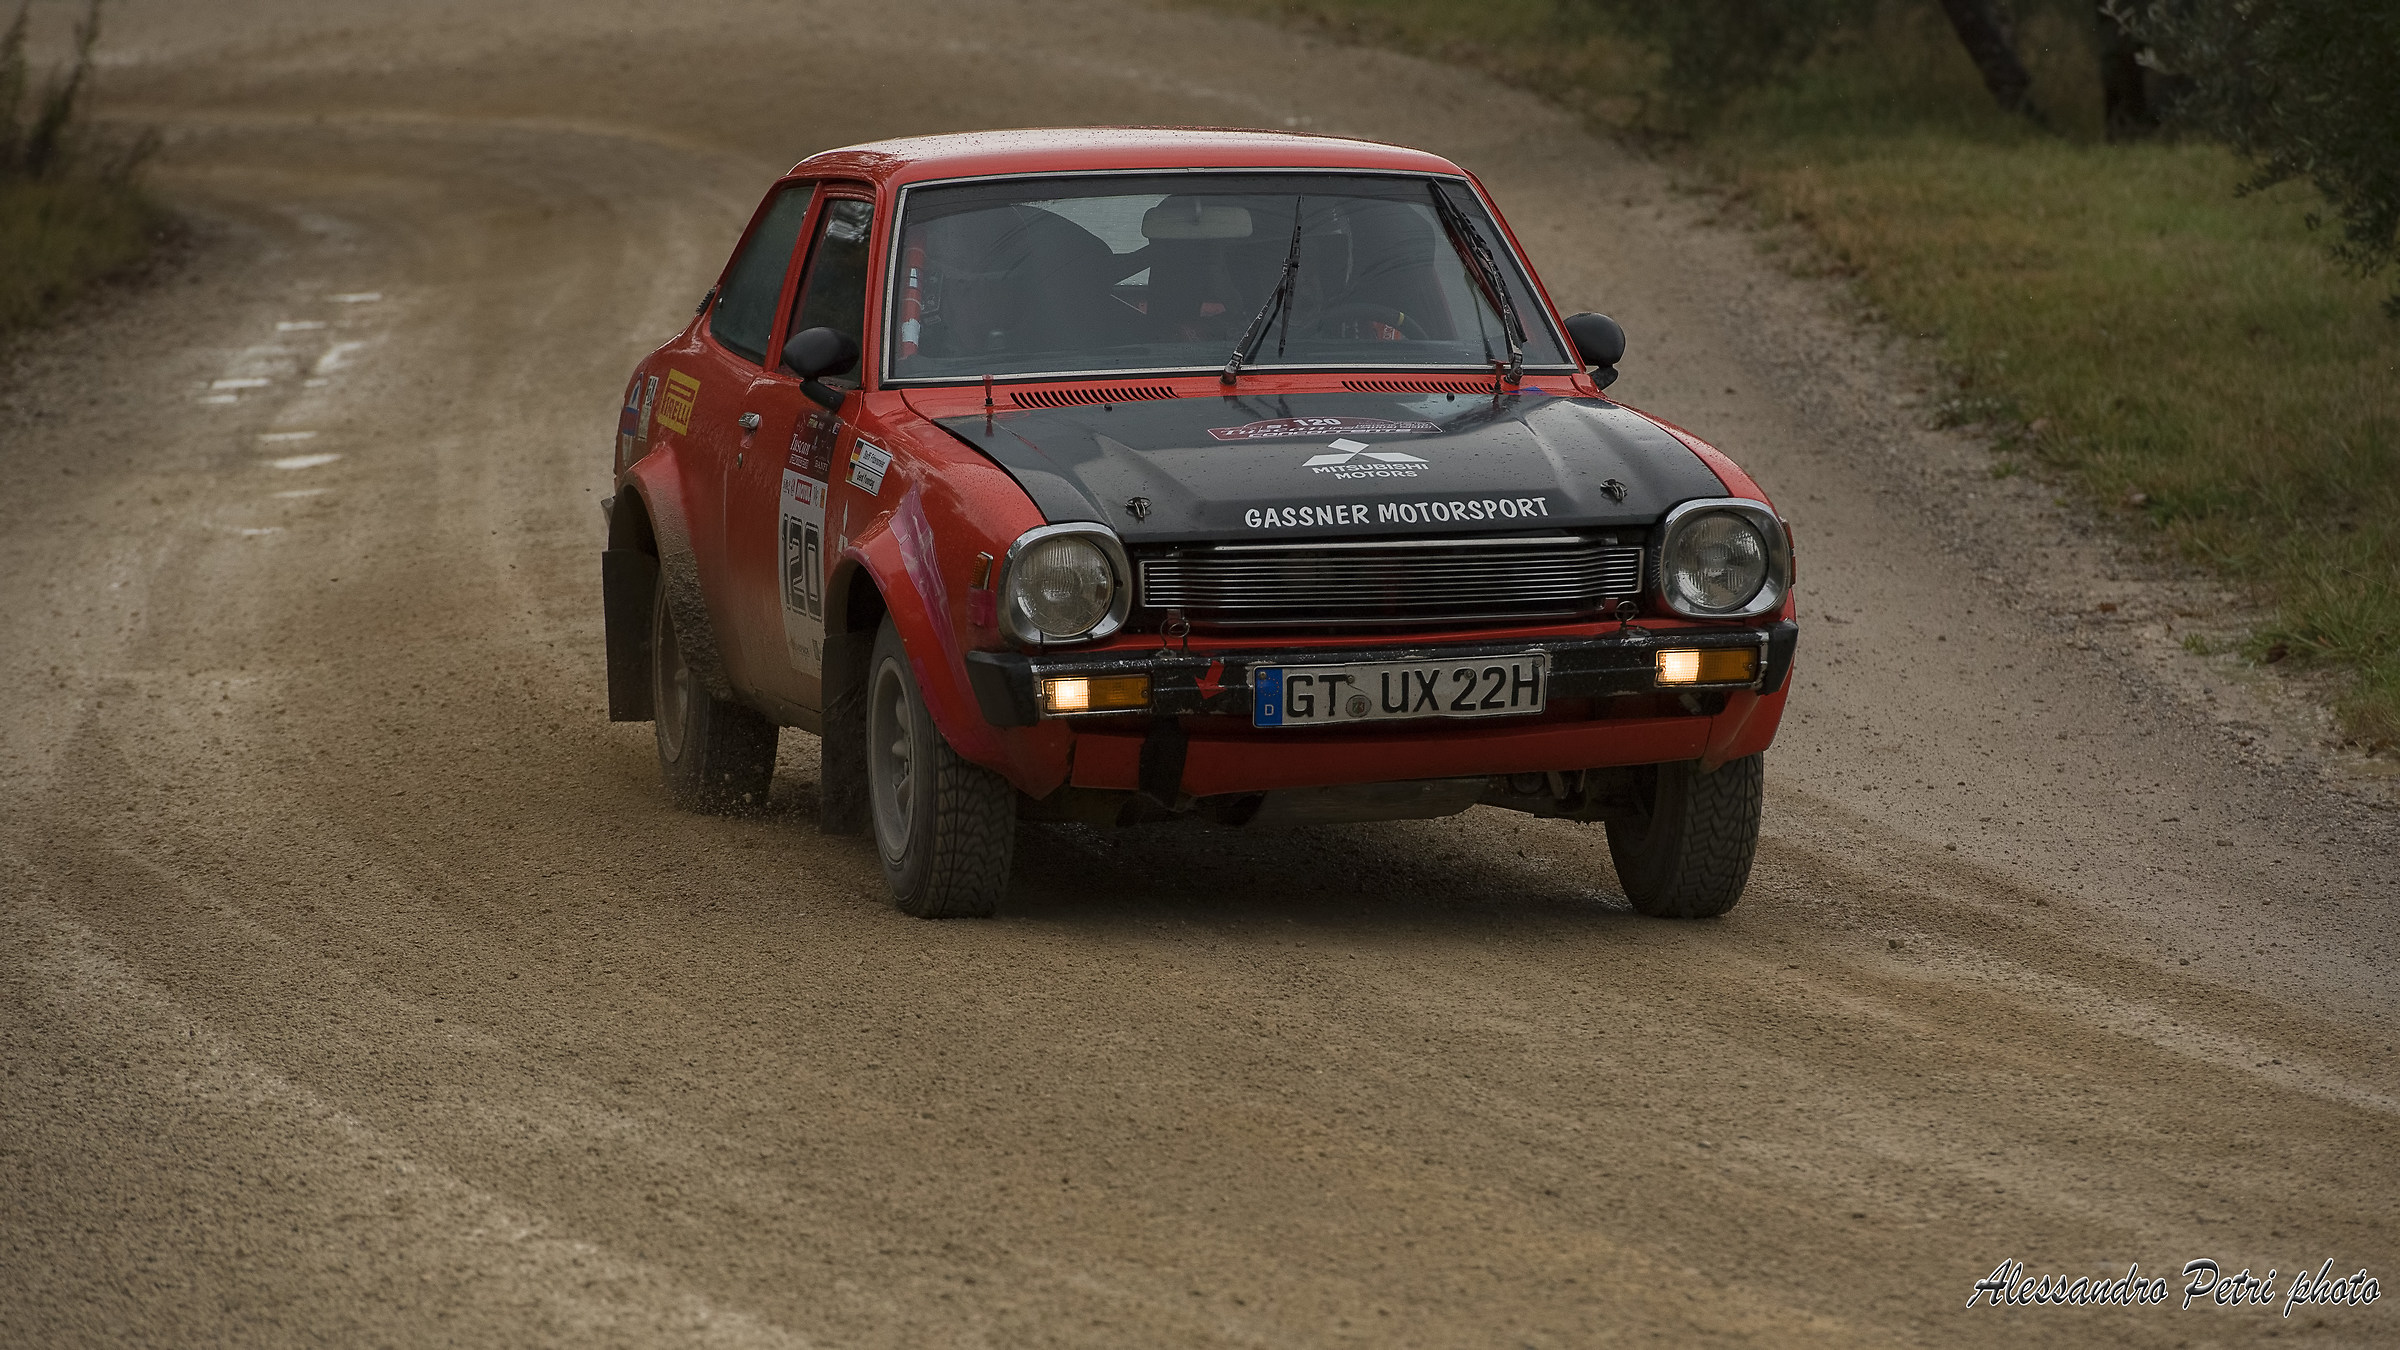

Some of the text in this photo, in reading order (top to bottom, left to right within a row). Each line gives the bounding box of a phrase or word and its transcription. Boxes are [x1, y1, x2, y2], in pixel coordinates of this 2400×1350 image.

[660, 378, 696, 426] PIRELLI
[1293, 418, 1341, 426] 120
[1312, 463, 1429, 474] MITSUBISHI
[1334, 470, 1418, 480] MOTORS
[1244, 497, 1548, 528] GASSNER MOTORSPORT
[782, 513, 822, 623] 120
[1286, 663, 1539, 717] GT UX 22H
[1264, 704, 1274, 716] D
